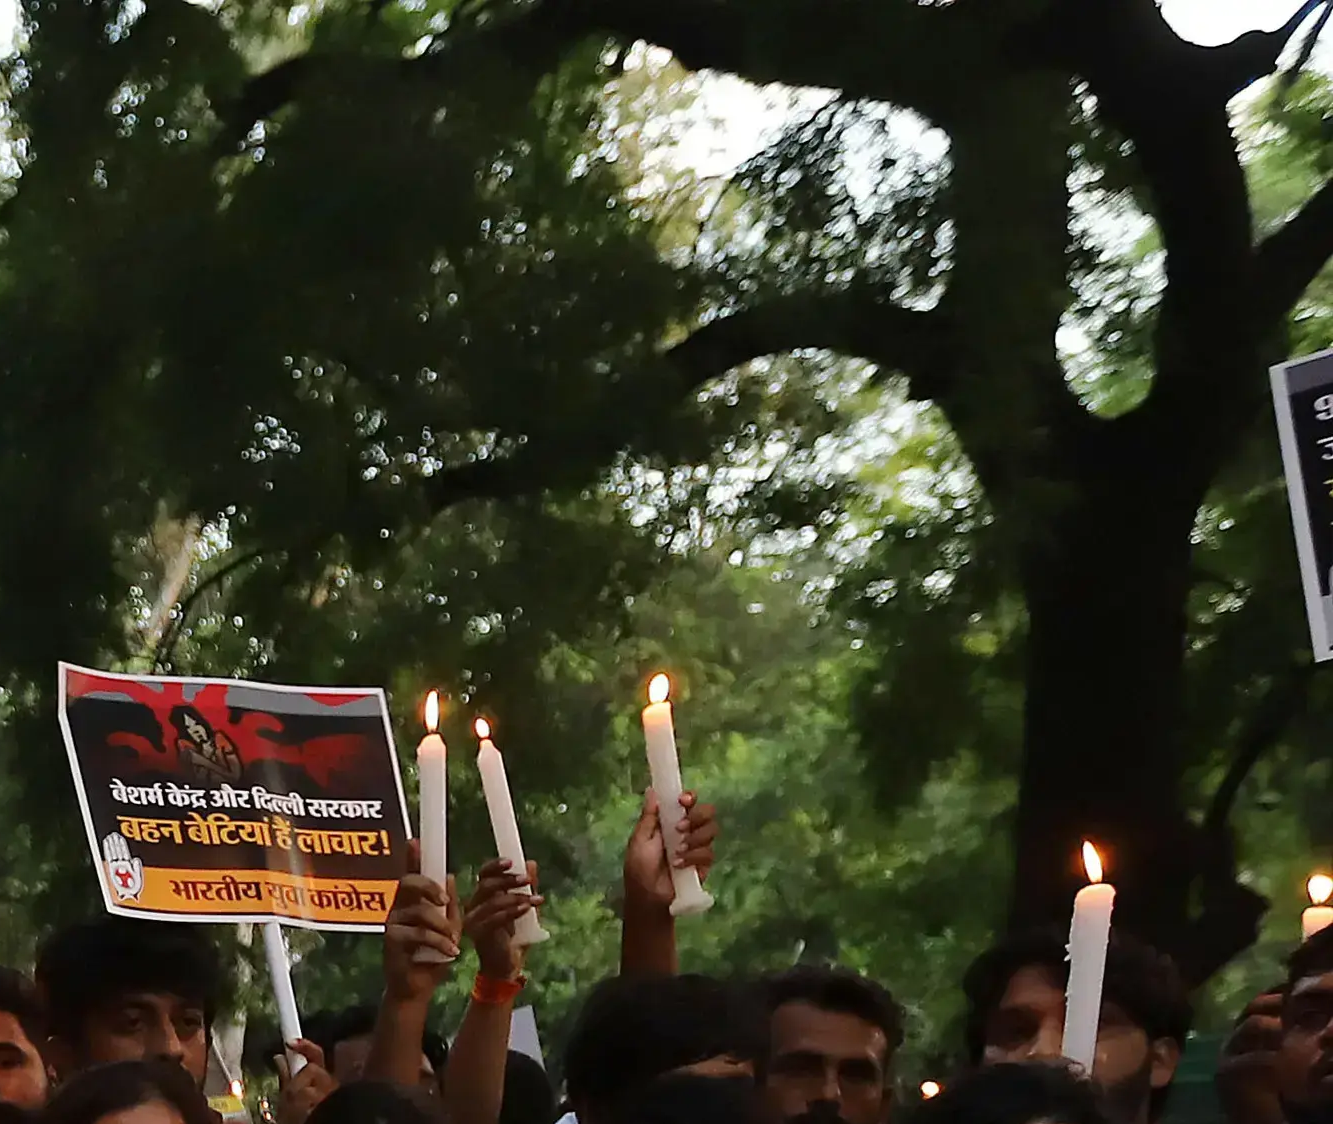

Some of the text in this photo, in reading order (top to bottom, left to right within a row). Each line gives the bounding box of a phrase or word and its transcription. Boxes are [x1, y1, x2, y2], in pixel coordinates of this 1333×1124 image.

[110, 778, 383, 818] बेशर्म केंद्र और दिल्ली सरकार
[117, 811, 390, 855] बहन बेटियां हैं लाचार!
[169, 875, 386, 911] भारतीय युवा कांग्रेस
